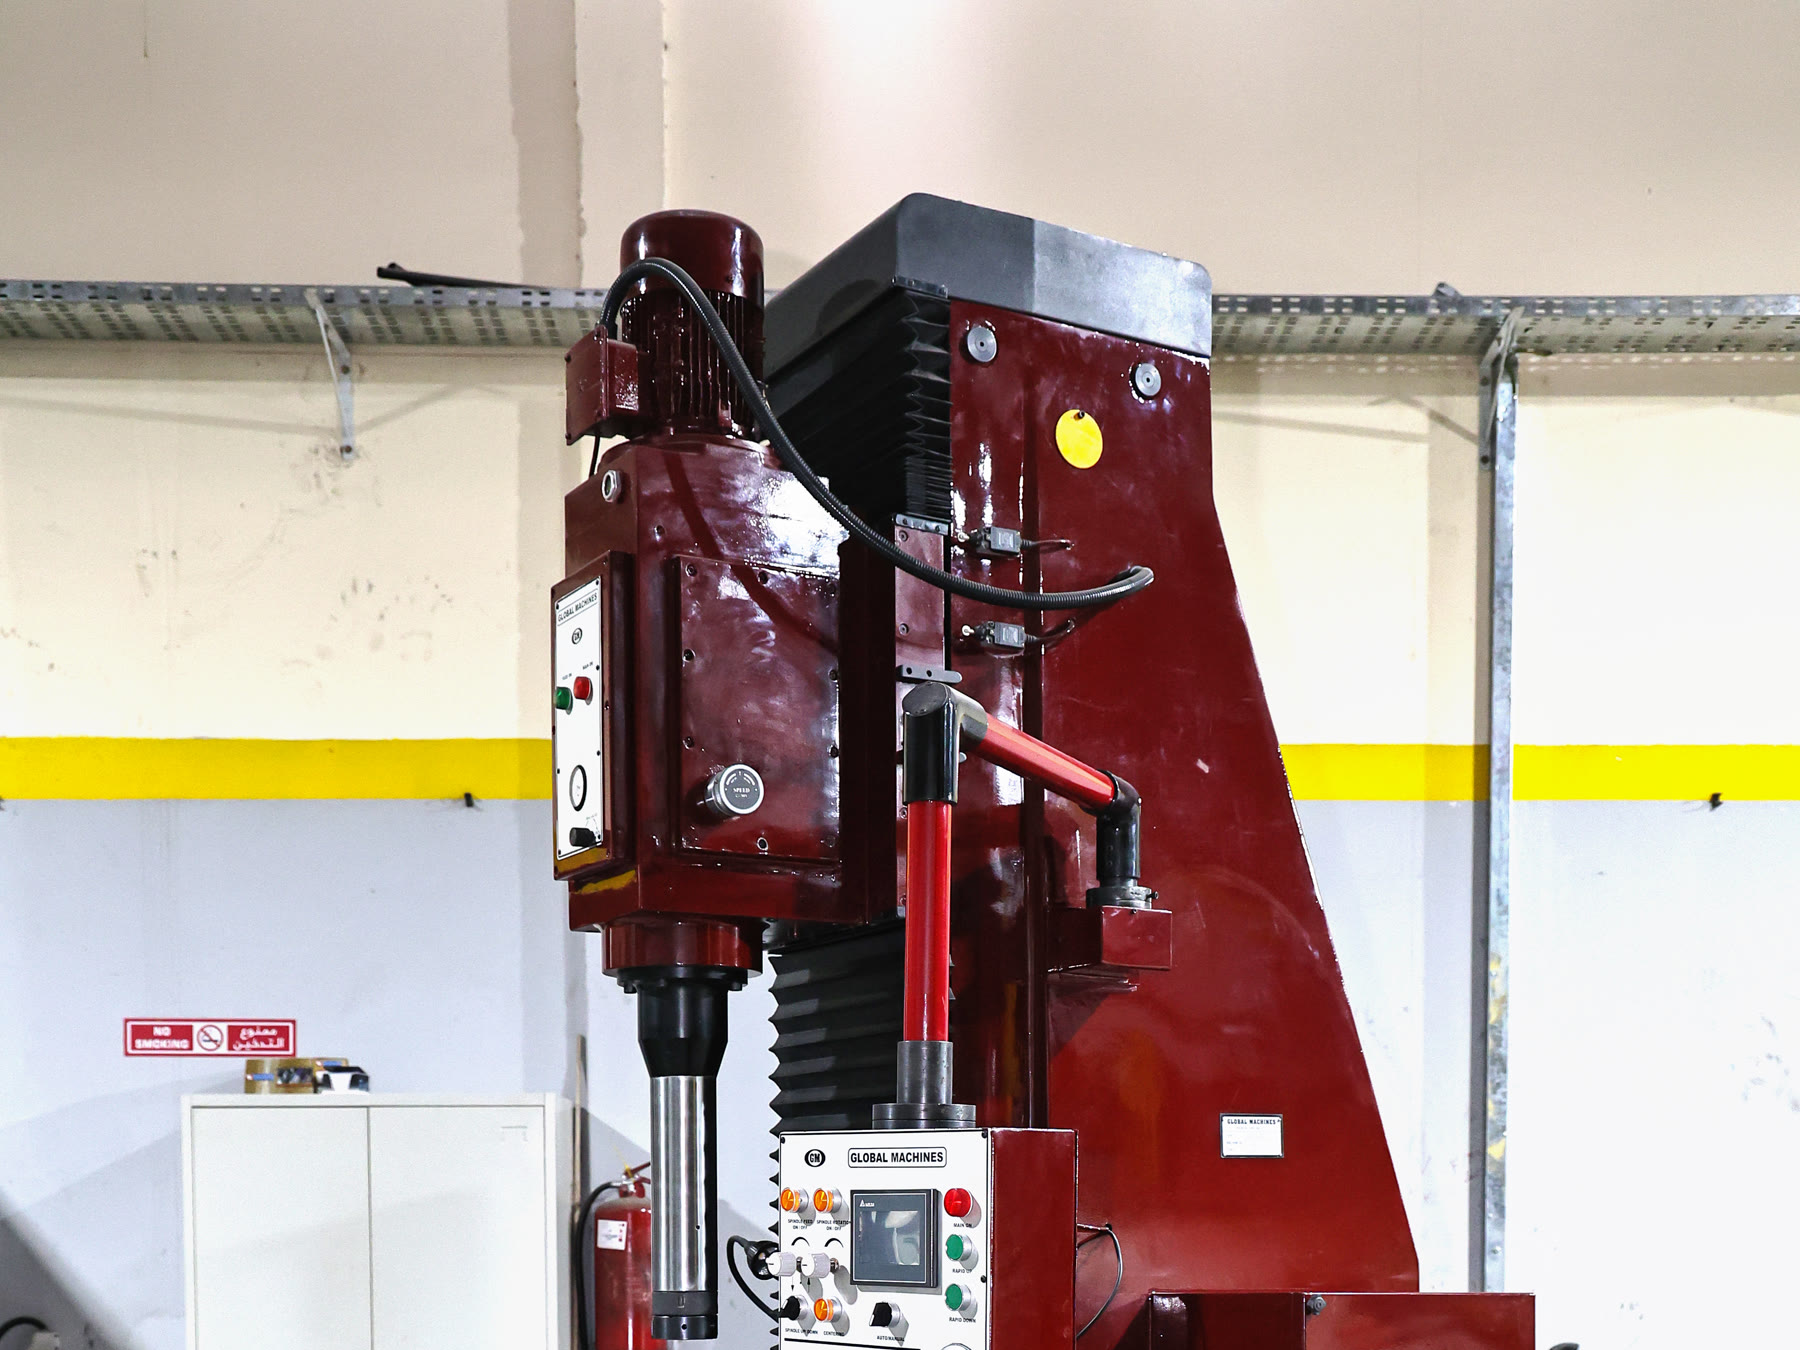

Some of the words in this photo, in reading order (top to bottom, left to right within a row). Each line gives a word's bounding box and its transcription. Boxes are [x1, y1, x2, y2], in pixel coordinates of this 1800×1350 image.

[558, 606, 575, 622] GLOBAL
[575, 592, 598, 611] MACHINES
[153, 1026, 171, 1036] NO
[239, 1026, 278, 1040] ممنوع
[135, 1039, 189, 1049] SMOKING
[232, 1037, 285, 1050] التدخين
[850, 1152, 888, 1163] GLOBAL
[891, 1151, 944, 1163] MACHINES
